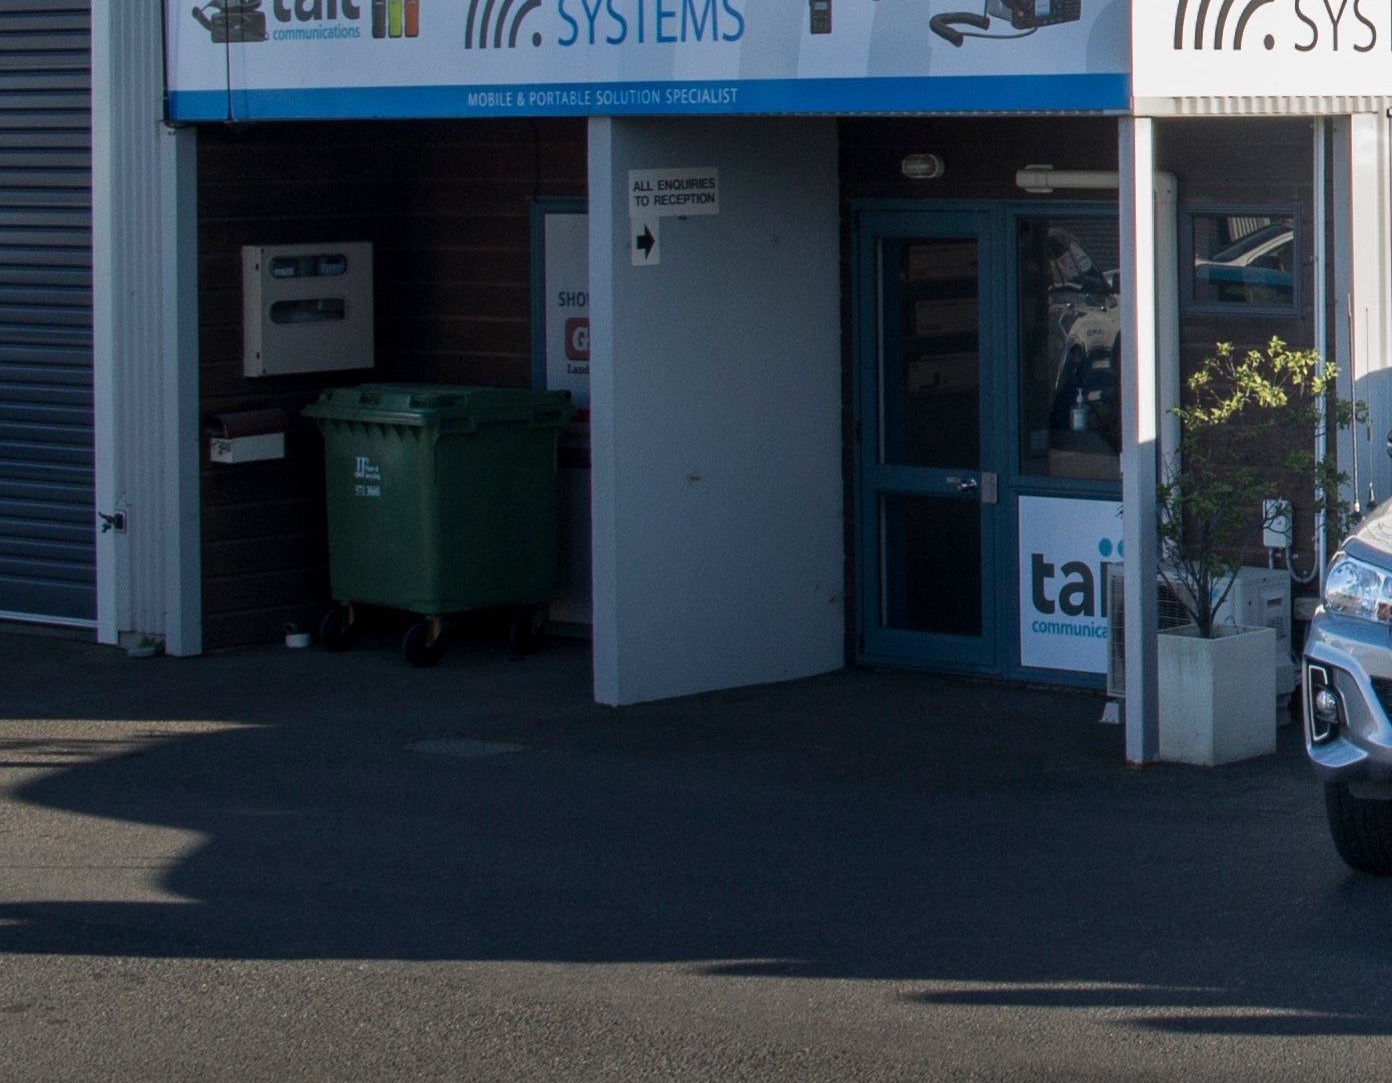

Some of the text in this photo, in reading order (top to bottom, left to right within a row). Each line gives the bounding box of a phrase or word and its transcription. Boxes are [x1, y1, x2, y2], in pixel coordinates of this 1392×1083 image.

[273, 24, 360, 41] communications
[468, 88, 738, 107] MOBILE & PORTABLE SOLUTION SPECIALIST
[633, 177, 716, 192] ALL ENQUIRIES
[634, 193, 716, 207] TO RECEPTION
[558, 291, 589, 307] SHO
[1031, 538, 1123, 617] tai
